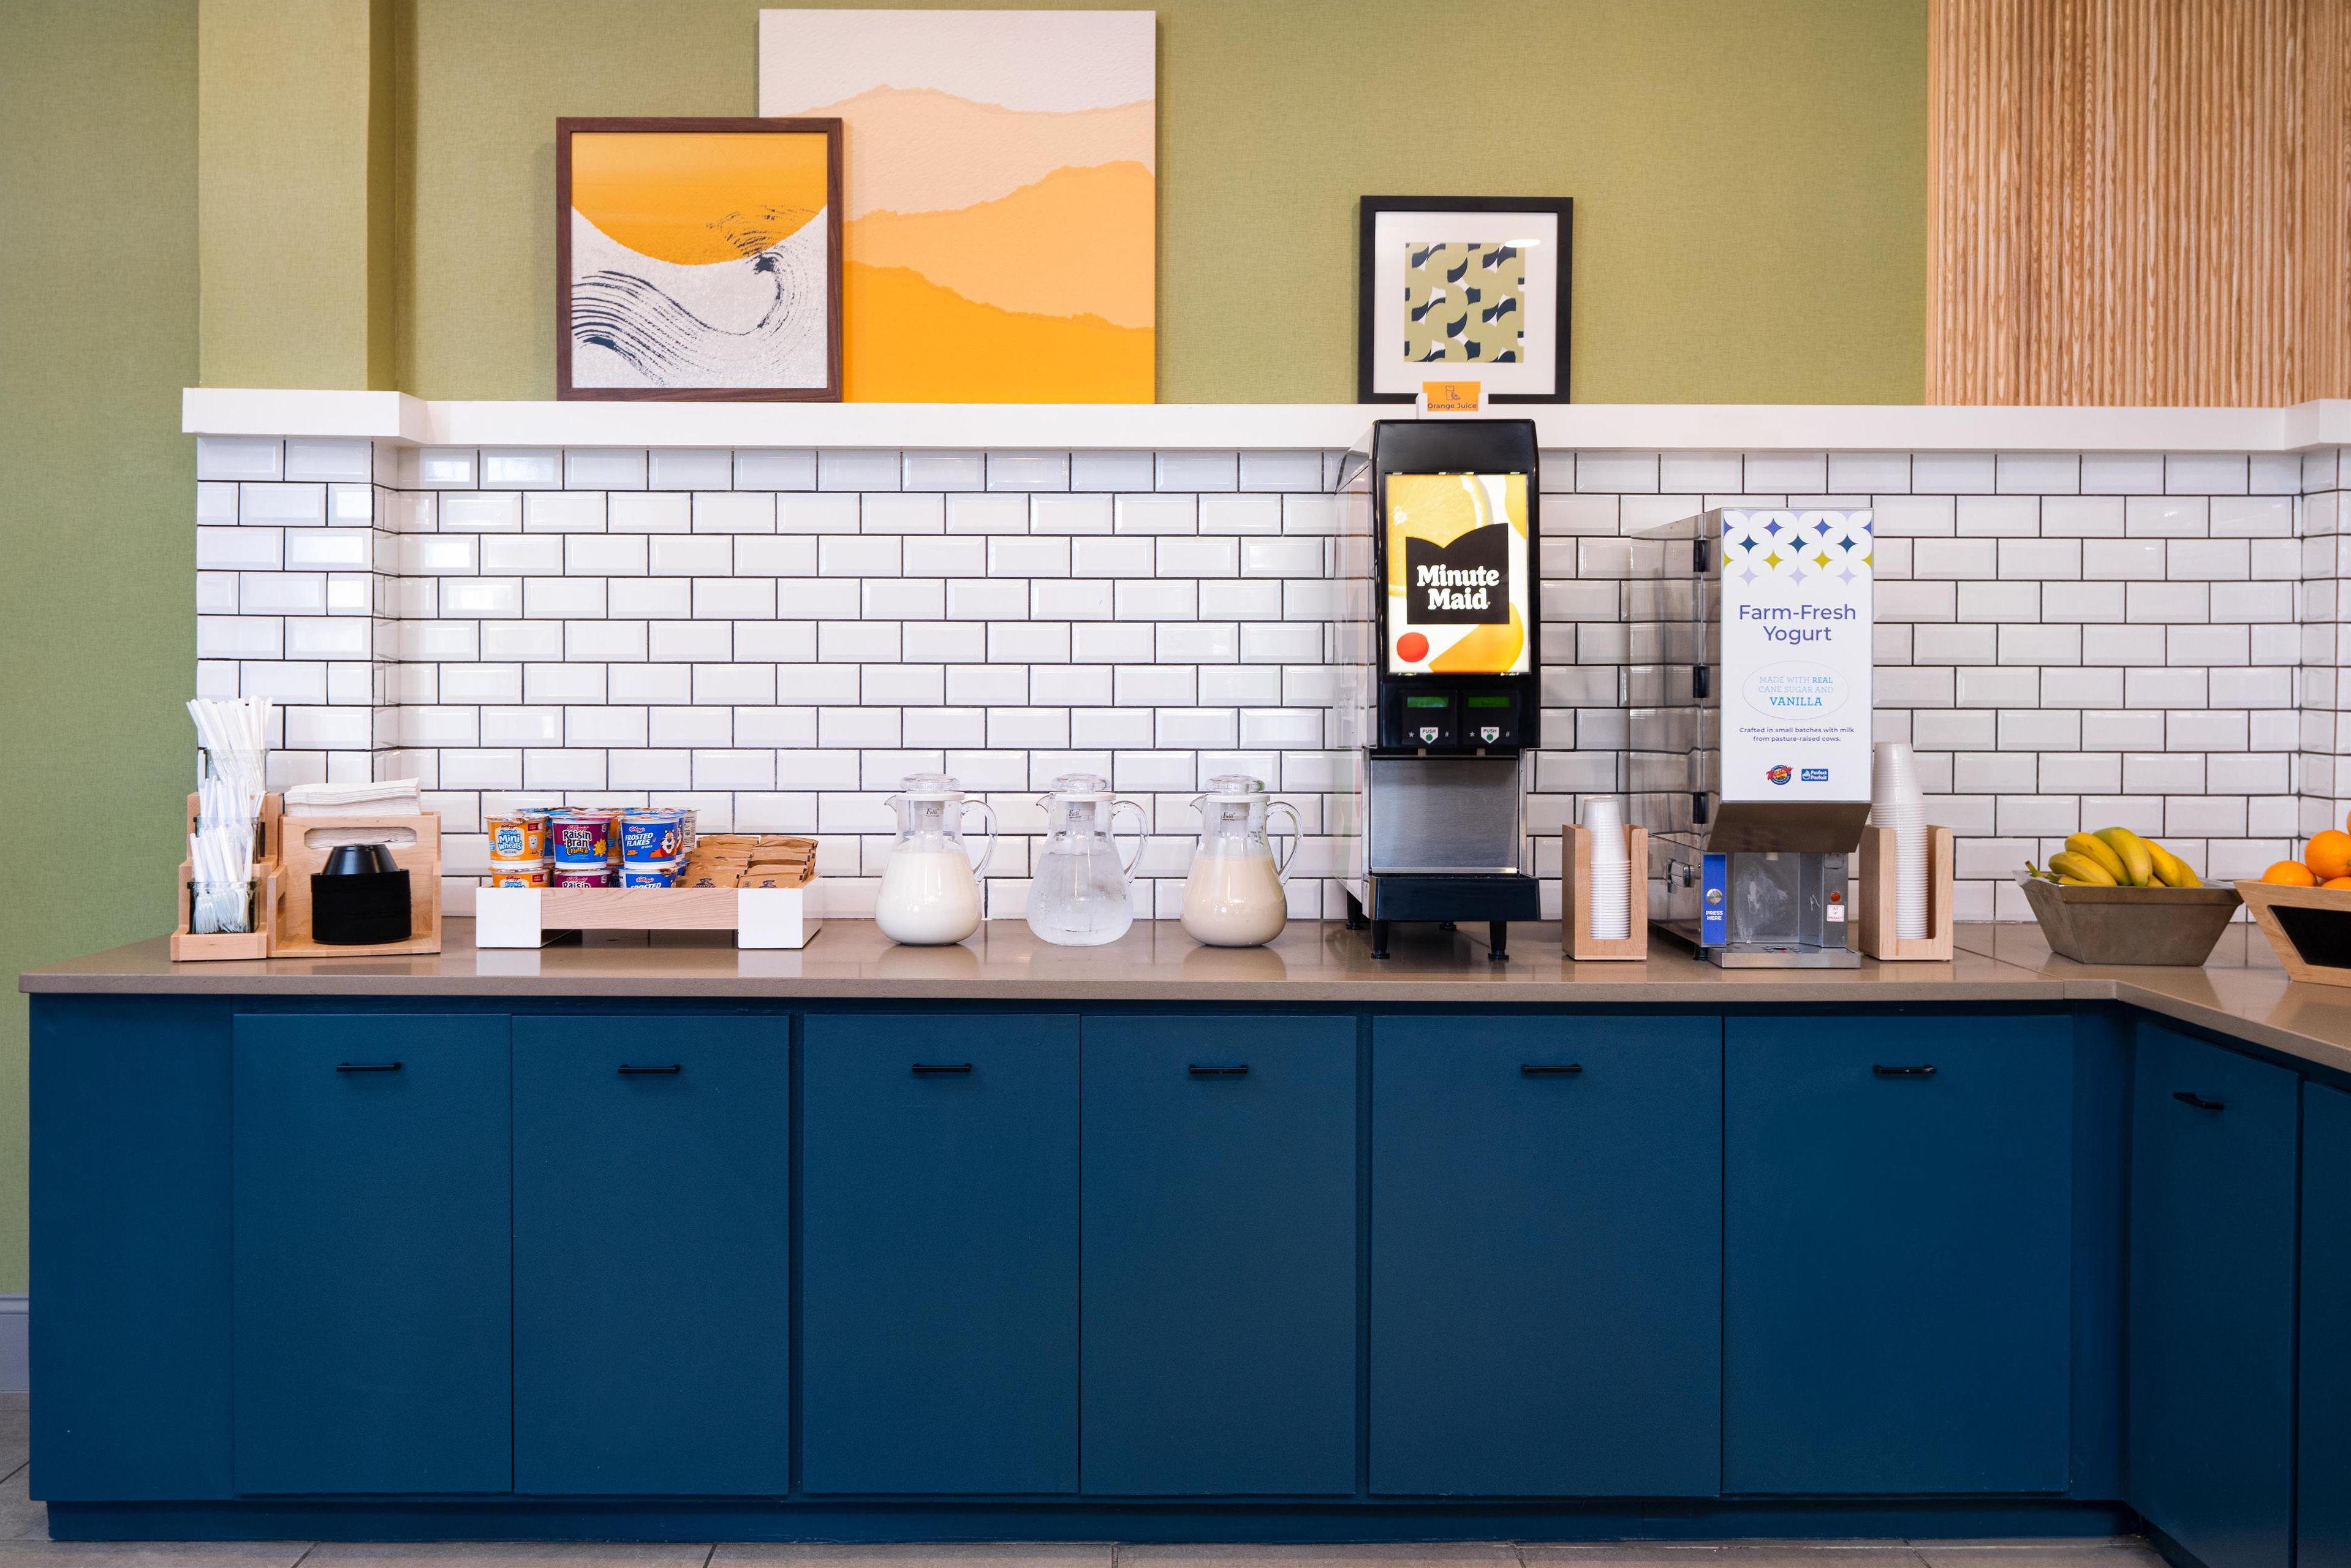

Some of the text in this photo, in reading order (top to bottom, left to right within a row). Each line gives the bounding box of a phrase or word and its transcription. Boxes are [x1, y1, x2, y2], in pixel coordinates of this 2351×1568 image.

[1416, 564, 1500, 586] Minute
[1428, 587, 1489, 610] Maid
[1739, 604, 1856, 620] Farm-Fresh
[1762, 626, 1832, 645] Yogurt
[1770, 697, 1823, 706] VANILLA
[499, 834, 521, 843] Mini
[563, 830, 591, 840] Raisin
[498, 841, 522, 850] Wheats
[567, 839, 588, 848] Bran
[566, 847, 589, 855] Crunch
